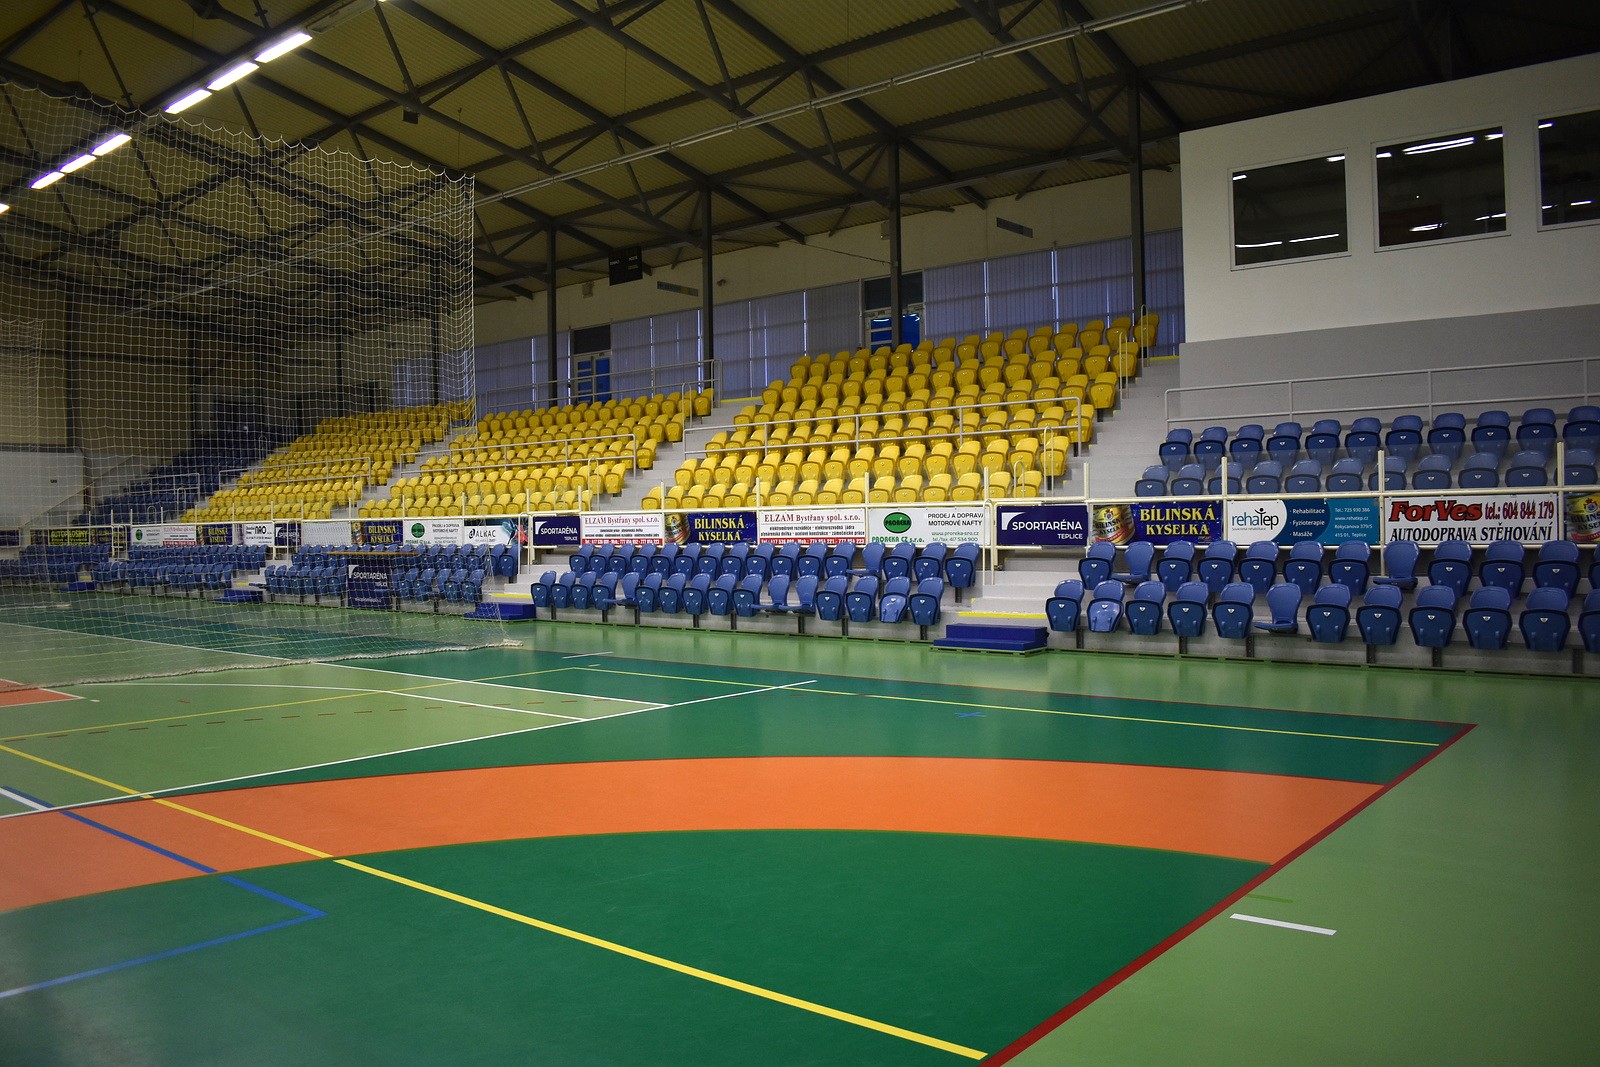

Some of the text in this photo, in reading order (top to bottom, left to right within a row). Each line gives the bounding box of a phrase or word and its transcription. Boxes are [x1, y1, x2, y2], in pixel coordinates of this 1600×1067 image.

[1140, 504, 1215, 521] BÍLINSKÁ
[1388, 500, 1483, 522] ForVes
[1502, 500, 1518, 519] 604
[1520, 500, 1536, 519] 844
[1538, 501, 1554, 519] 179
[585, 517, 607, 525] ELZAM
[608, 516, 631, 525] Bystřany
[695, 515, 744, 529] BÍLINSKÁ
[764, 514, 794, 522] ELZAM
[796, 514, 825, 523] Bystřany
[541, 526, 578, 535] SPORTARÉNA
[1012, 519, 1083, 531] SPORTARÉNA
[1146, 524, 1209, 535] KYSELKA
[699, 531, 741, 541] KYSELKA
[1390, 522, 1553, 541] AUTODOPRAVA STĚHOVÁNÍ
